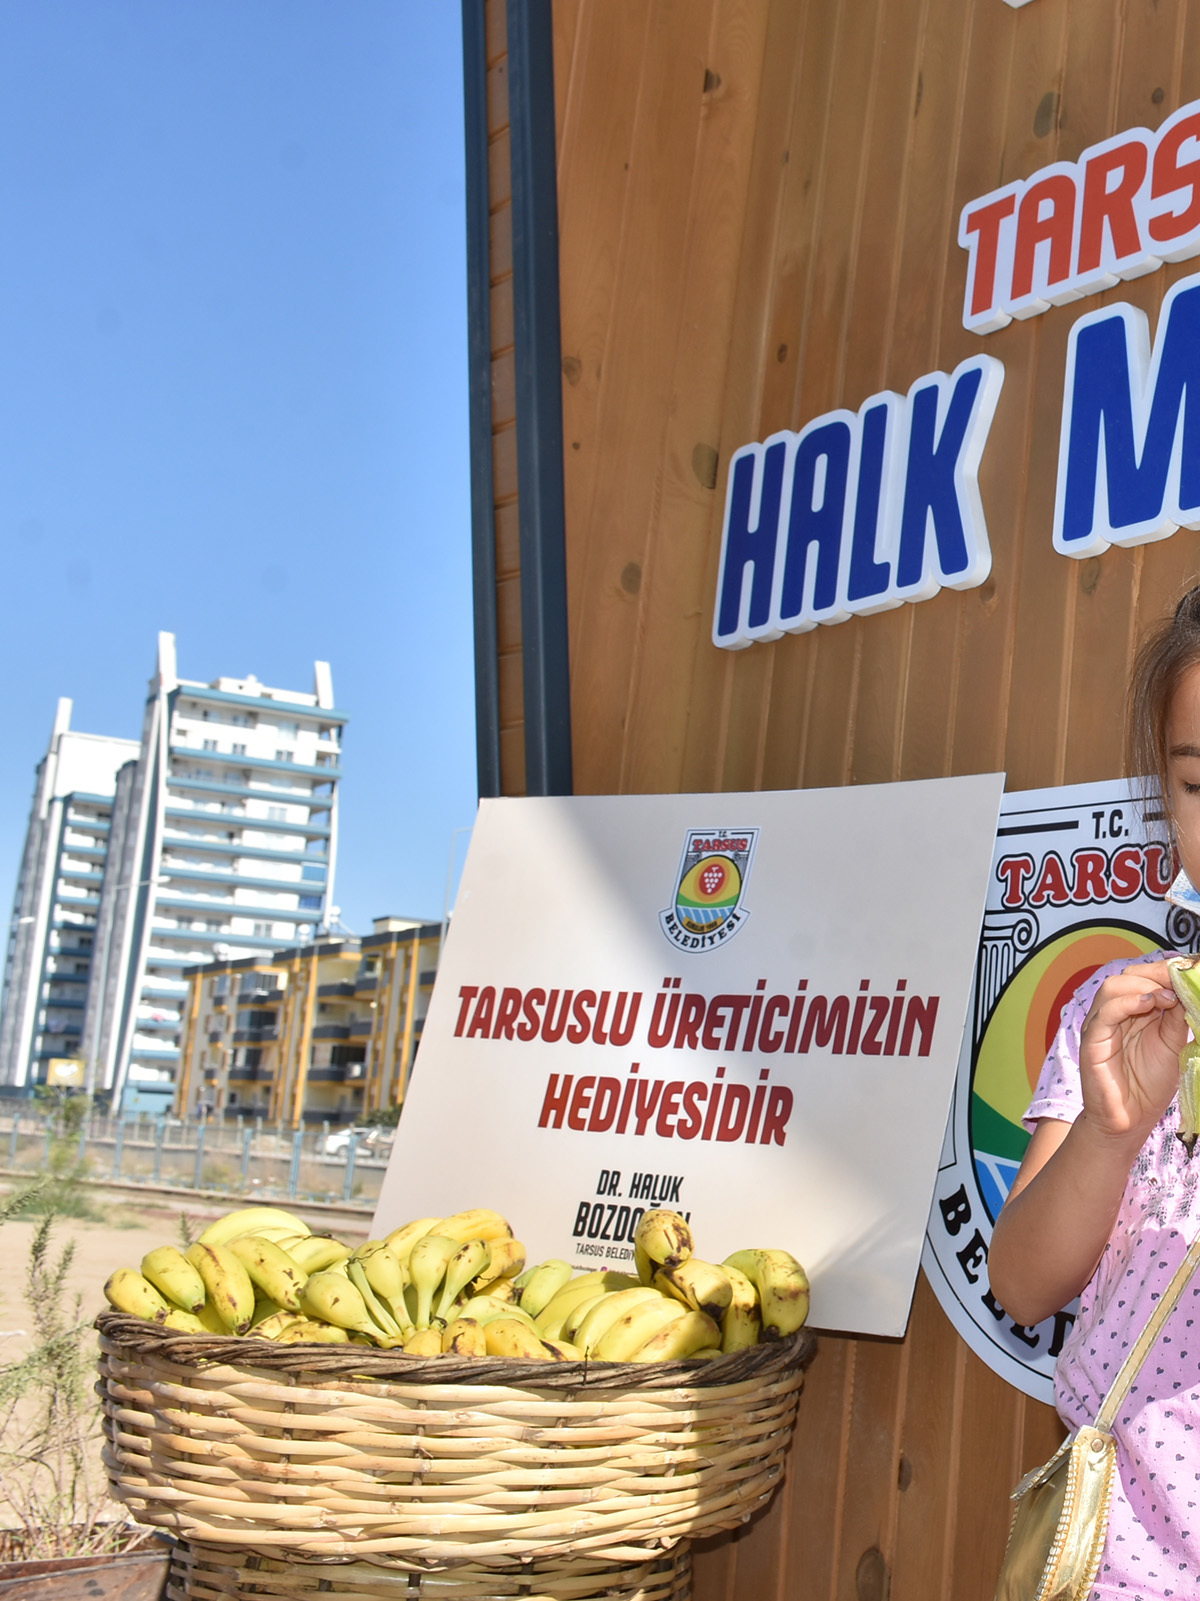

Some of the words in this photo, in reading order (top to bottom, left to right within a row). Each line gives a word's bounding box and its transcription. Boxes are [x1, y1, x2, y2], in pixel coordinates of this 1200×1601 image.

[717, 366, 984, 638] HALK
[692, 838, 748, 852] TARSUS
[1092, 809, 1129, 839] T.C.
[997, 841, 1181, 908] TARSU
[454, 985, 644, 1047] TARSUSLU
[648, 977, 940, 1056] ÜRETİCİMİZİN
[538, 1062, 794, 1146] HEDİYESİDİR
[596, 1170, 622, 1197] DR.
[629, 1172, 684, 1203] HALUK
[572, 1201, 691, 1244] BOZDO
[575, 1243, 604, 1259] TARSUS
